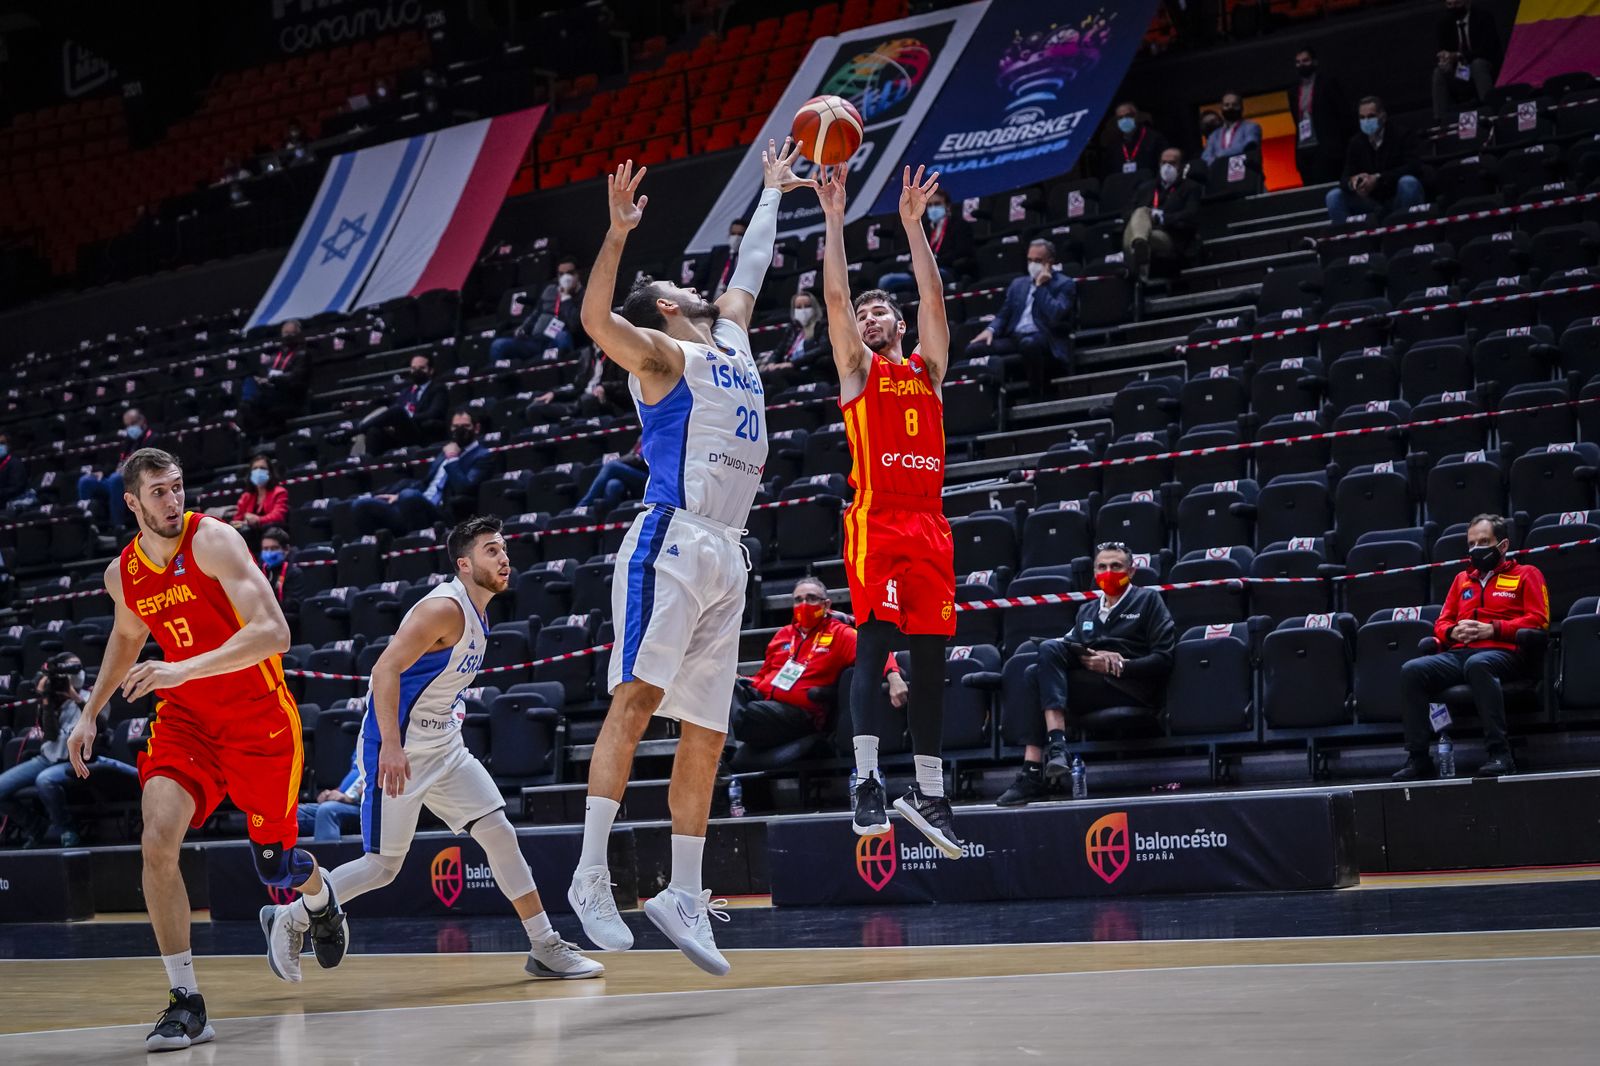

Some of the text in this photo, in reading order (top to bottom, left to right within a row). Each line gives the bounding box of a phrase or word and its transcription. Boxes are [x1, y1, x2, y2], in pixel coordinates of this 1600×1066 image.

[938, 108, 1089, 153] EUROBASKET
[926, 139, 1070, 174] QUALIFIERS
[735, 405, 759, 442] 20
[904, 408, 919, 437] 8
[136, 583, 197, 617] ESPAÑA
[163, 617, 194, 648] 13
[901, 839, 985, 860] balonsto
[1136, 851, 1175, 861] ESPAÑA
[902, 861, 938, 870] ESPAÑA
[466, 880, 496, 889] ESPAÑA
